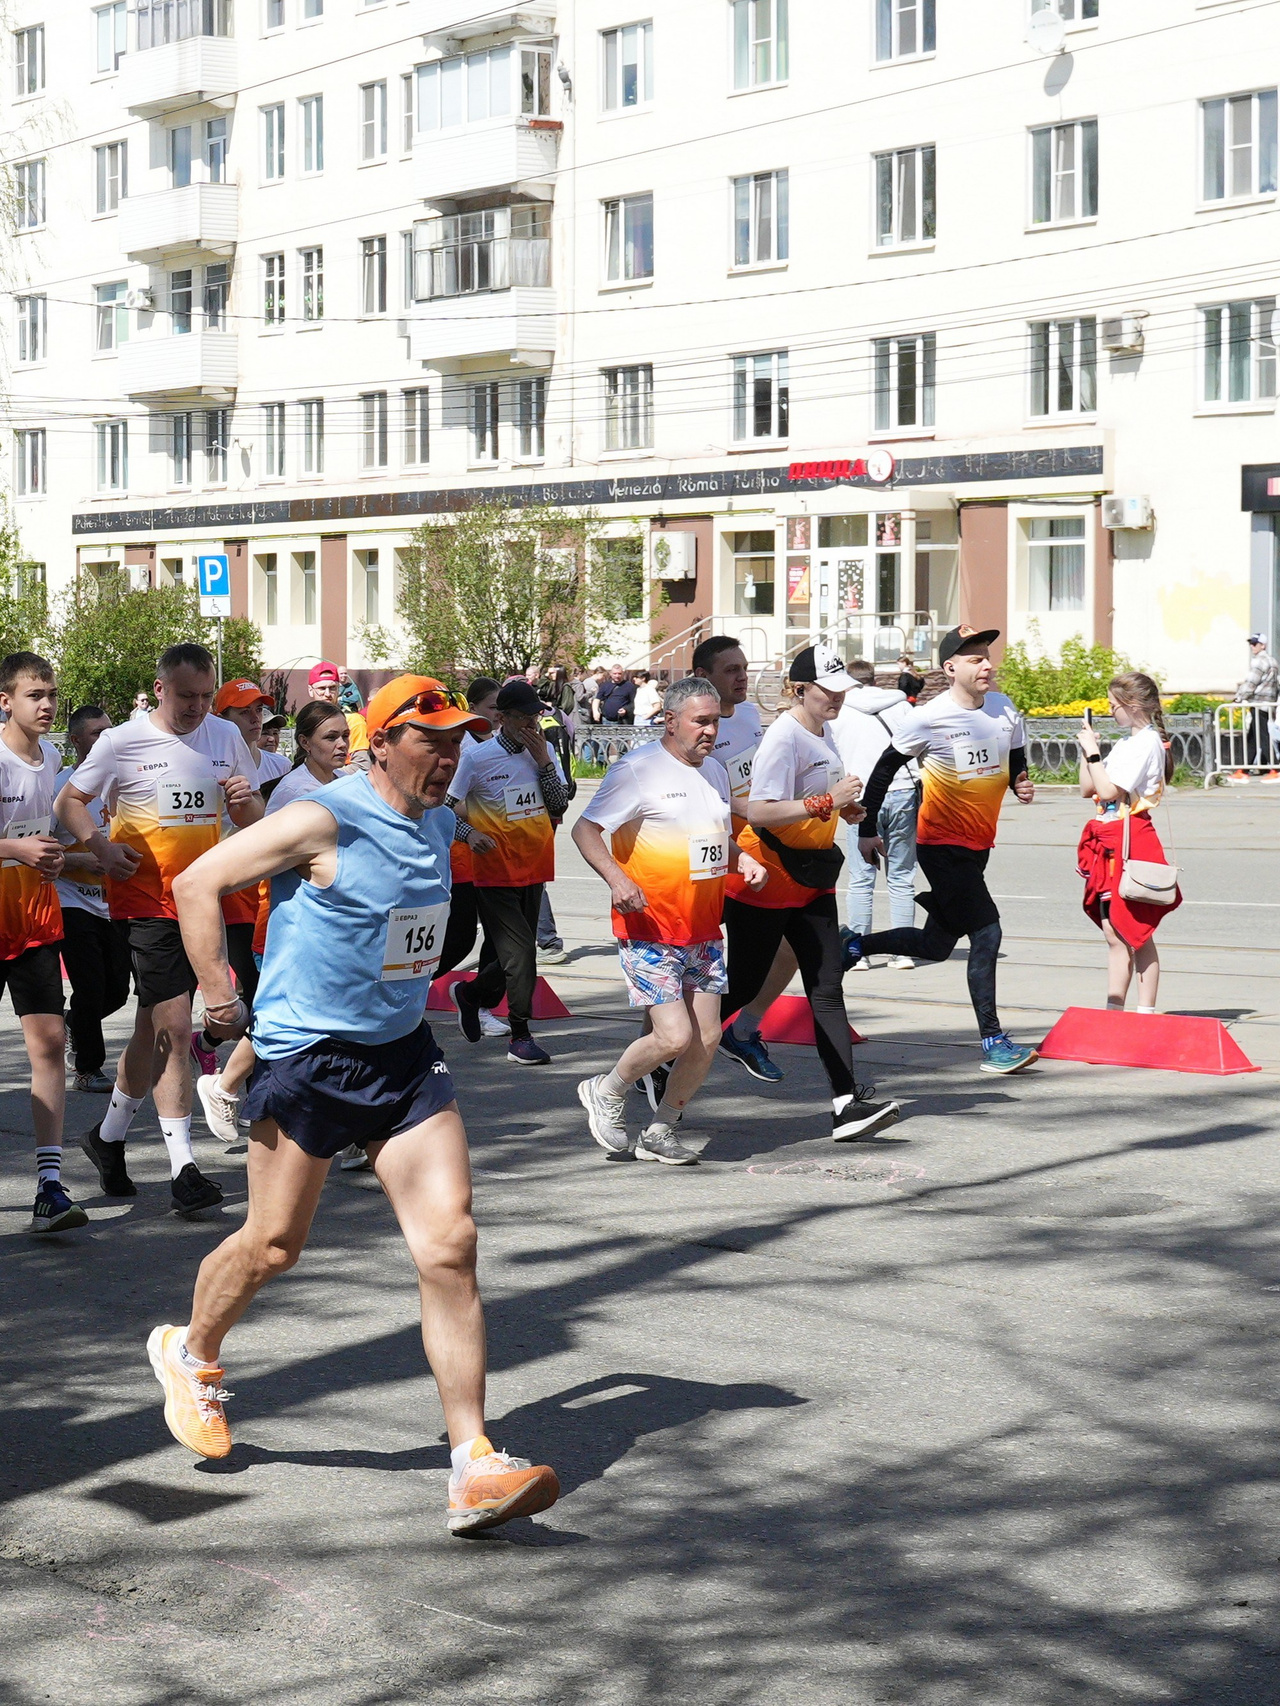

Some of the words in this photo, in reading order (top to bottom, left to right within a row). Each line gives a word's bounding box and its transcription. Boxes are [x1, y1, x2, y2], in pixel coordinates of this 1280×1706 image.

[788, 459, 867, 480] ПИЦЦА
[205, 559, 223, 592] P
[968, 749, 988, 765] 213
[143, 762, 169, 771] ЕВРАЗ
[172, 791, 205, 809] 328
[516, 792, 536, 806] 441
[701, 845, 723, 863] 783
[405, 924, 435, 954] 156
